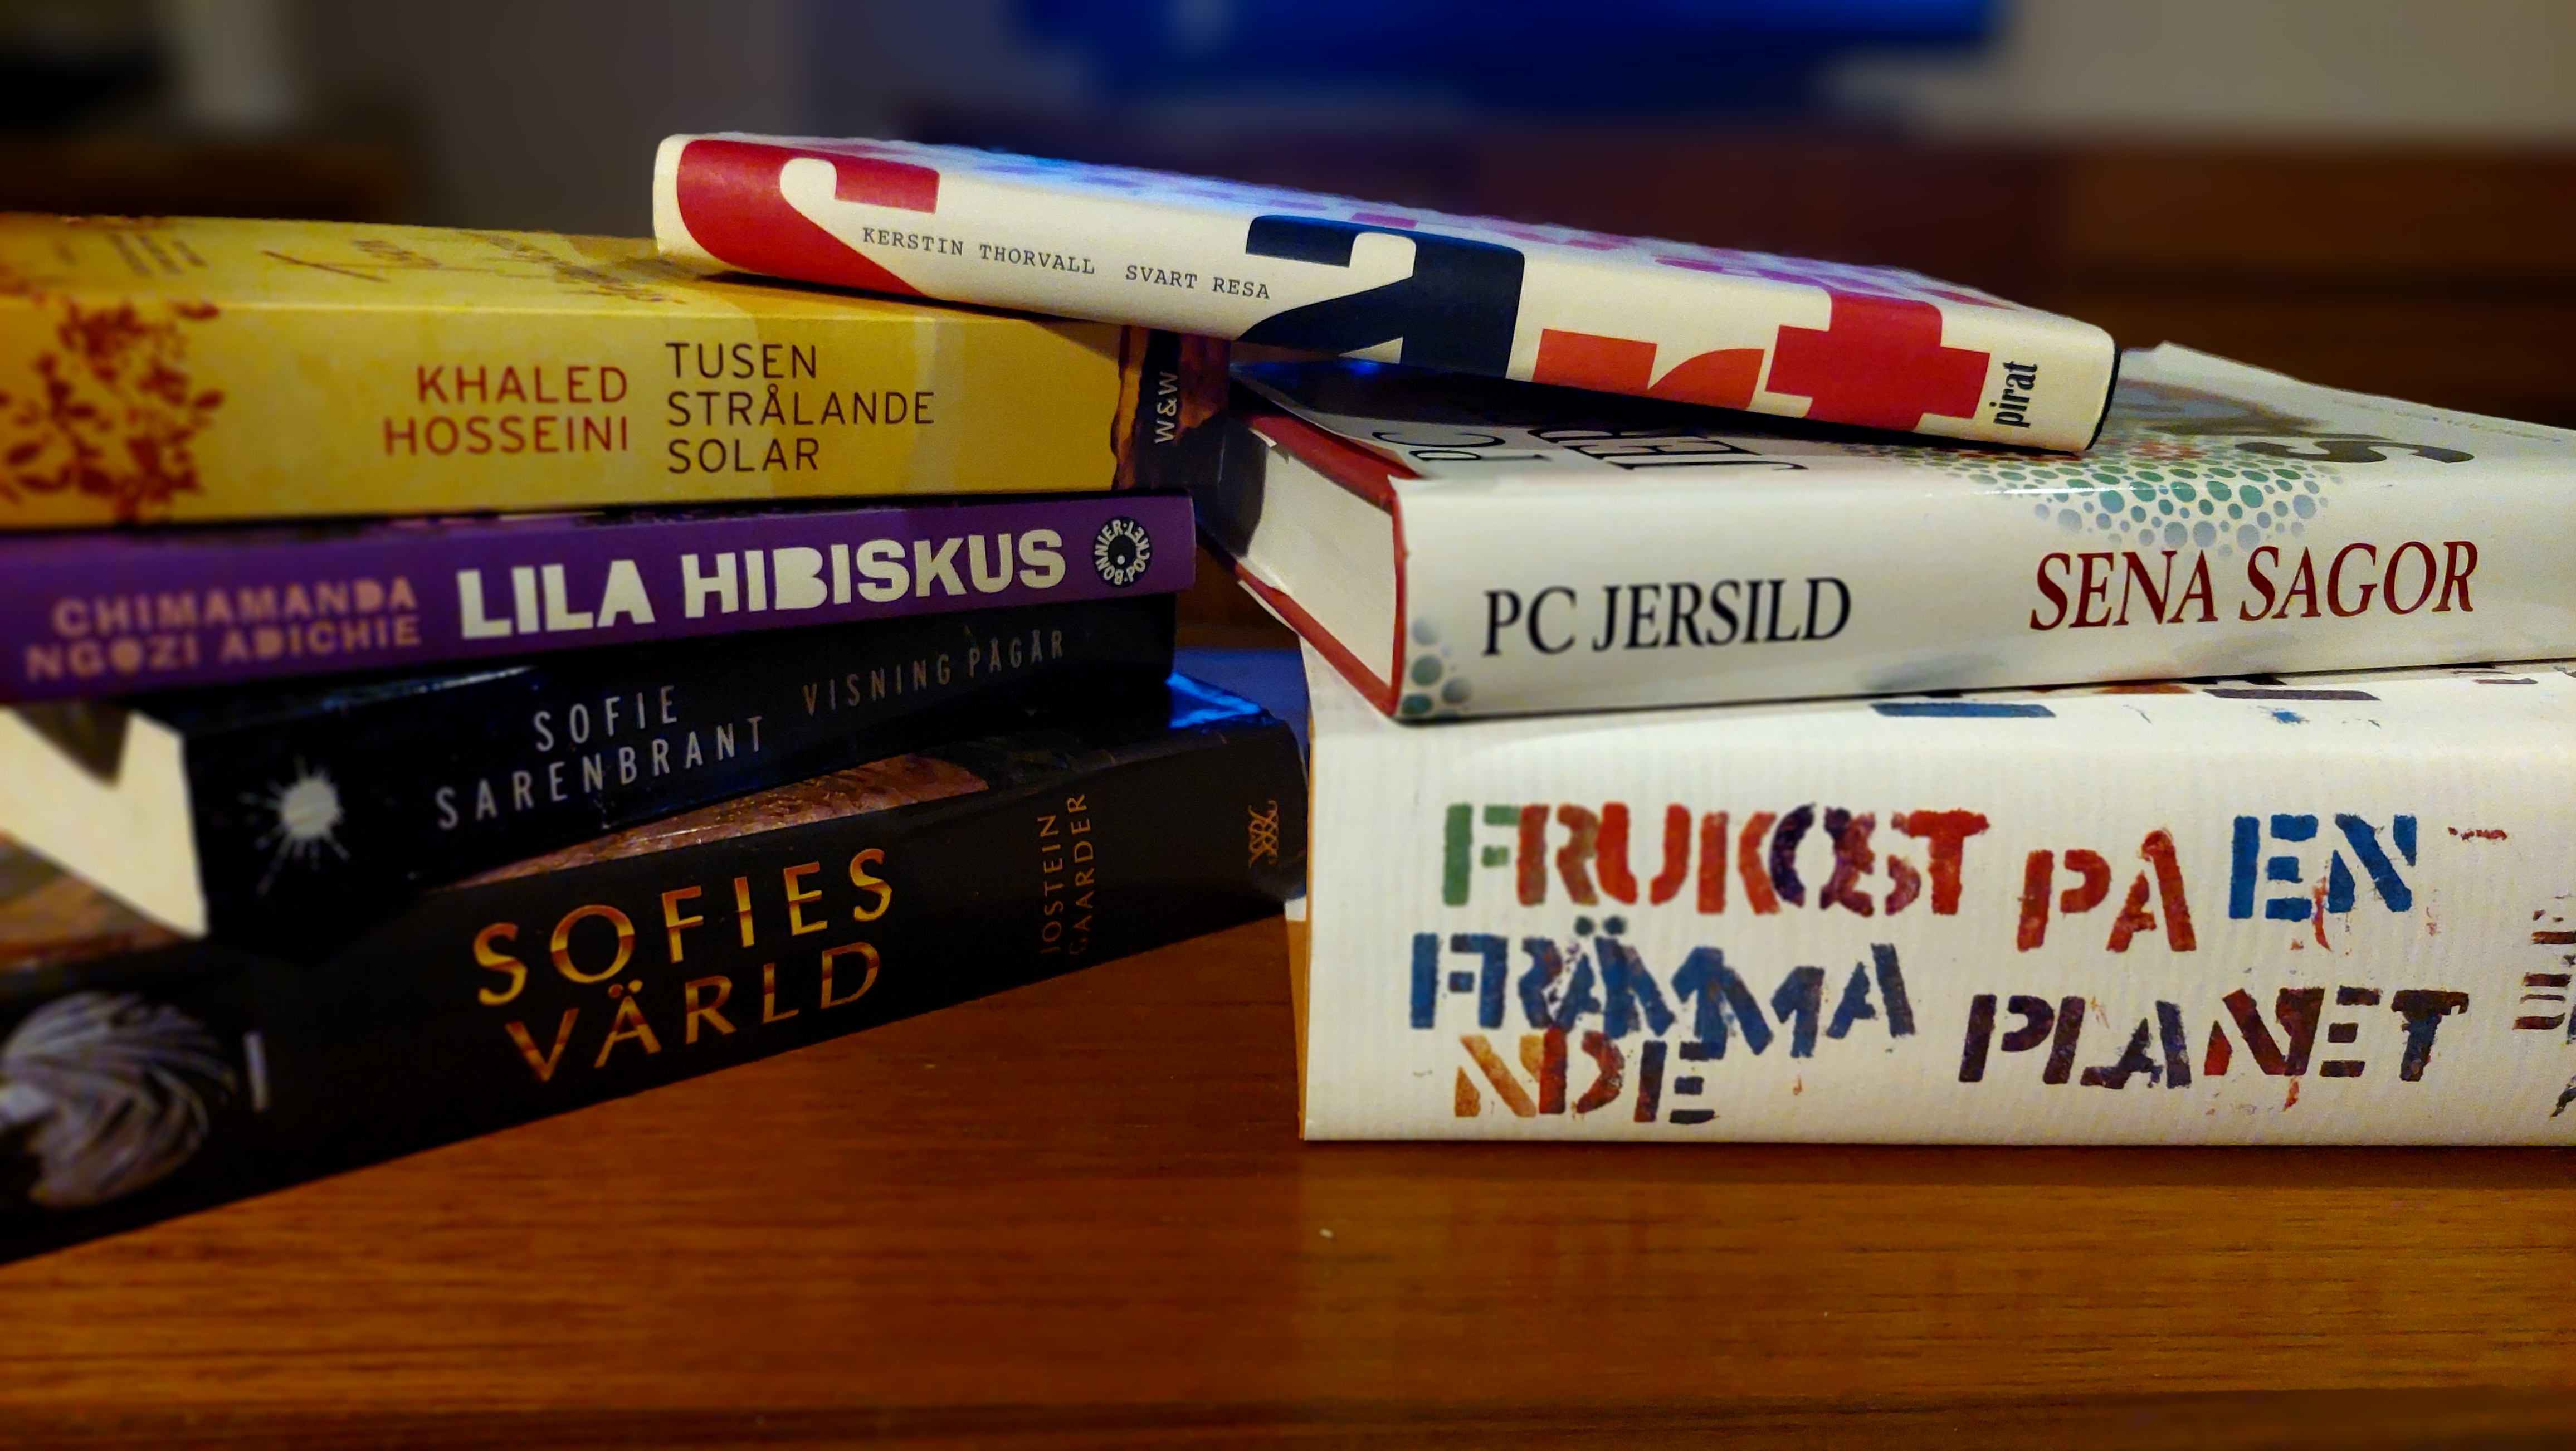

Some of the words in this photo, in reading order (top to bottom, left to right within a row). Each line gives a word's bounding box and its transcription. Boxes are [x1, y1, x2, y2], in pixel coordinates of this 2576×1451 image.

[862, 227, 963, 256] KERSTIN
[979, 244, 1095, 275] THORVALL
[1125, 265, 1198, 289] SVART
[1212, 275, 1270, 300] RESA
[417, 366, 627, 403] KHALED
[665, 342, 816, 379] TUSEN
[1989, 361, 2039, 429] pirat
[384, 416, 628, 456] HOSSEINI
[668, 383, 935, 427] STRÅLANDE
[1154, 371, 1180, 444] W&W
[668, 437, 819, 474] SOLAR
[53, 577, 418, 636] CHIMAMANDA
[457, 559, 656, 640] LILA
[681, 529, 1067, 620] HIBISKUS
[1482, 586, 1578, 656] PC
[1592, 577, 1852, 653] JERSILD
[2029, 549, 2219, 631] SENA
[2240, 541, 2479, 621] SAGOR
[26, 634, 199, 681] NGOZI
[221, 615, 421, 662] ADICHIE
[533, 680, 678, 751] SOFIE
[801, 653, 952, 717] VISNING
[435, 715, 763, 829] SARENBRANT
[1066, 793, 1094, 955] GAARDER
[1442, 801, 1990, 918] FRUKOST
[2228, 812, 2418, 921] EN
[473, 848, 892, 1006] SOFIES
[505, 941, 881, 1082] VÄRLD
[1958, 986, 2470, 1089] PLANET
[1453, 1028, 1716, 1124] NDE
